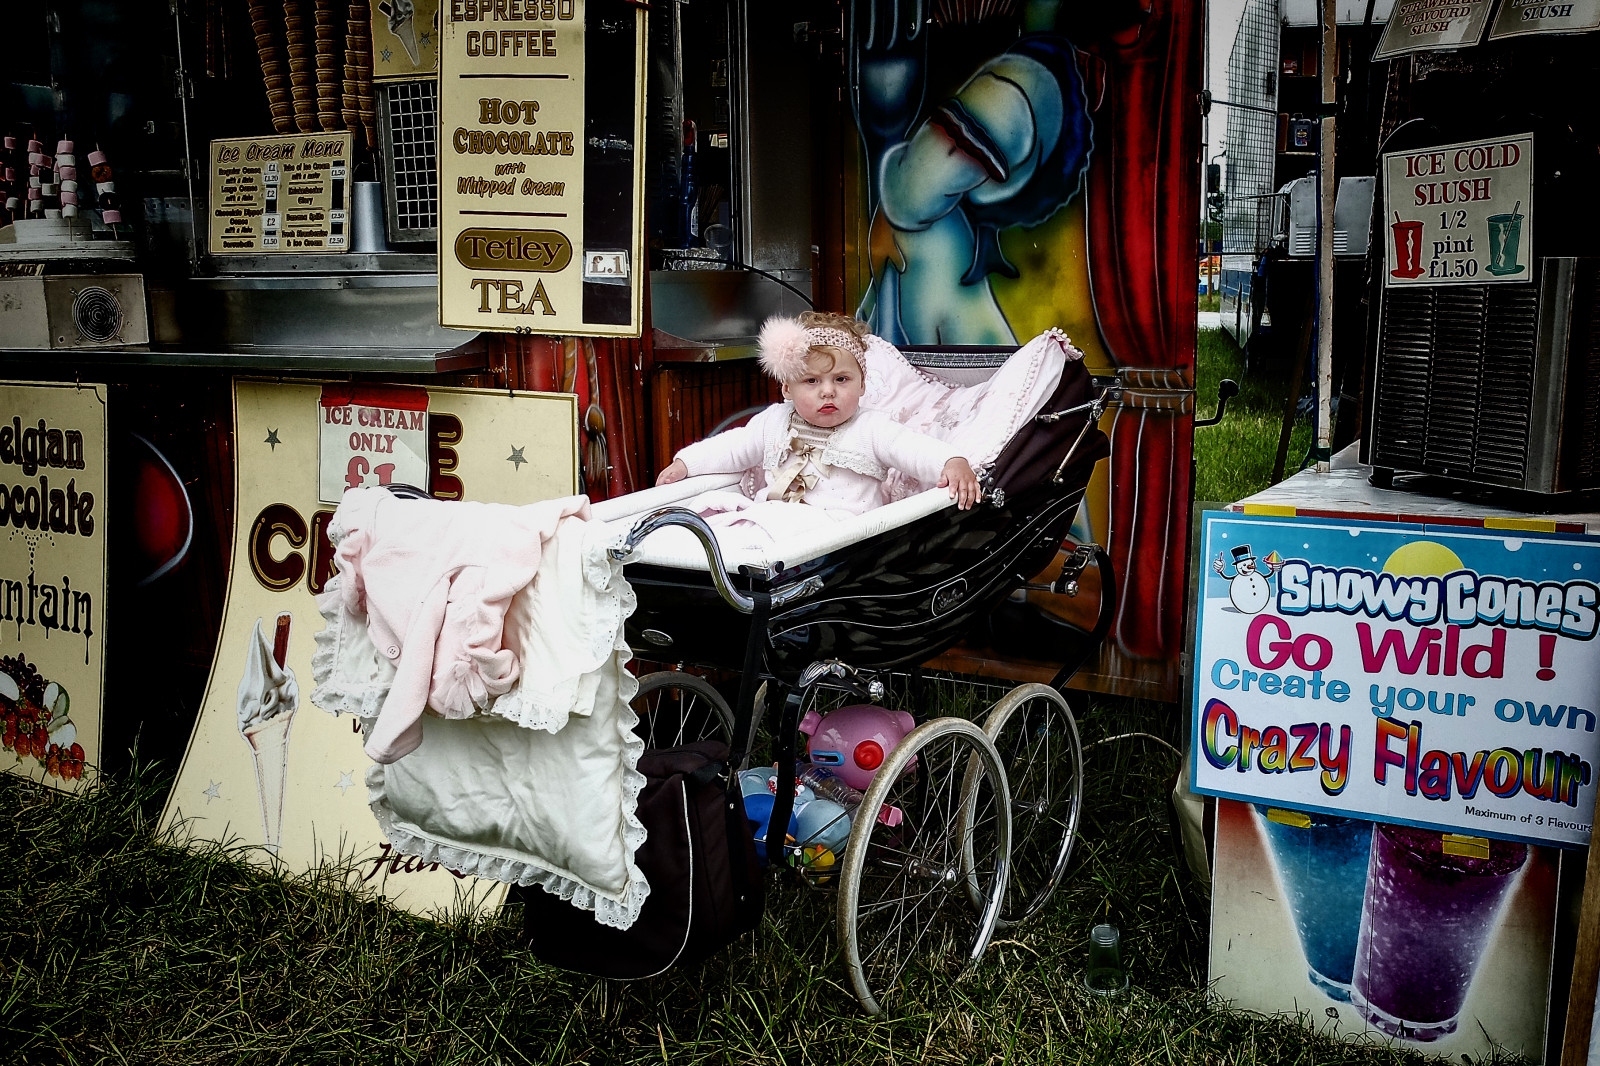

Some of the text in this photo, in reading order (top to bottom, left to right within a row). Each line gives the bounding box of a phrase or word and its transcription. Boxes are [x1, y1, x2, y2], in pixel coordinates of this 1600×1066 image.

[451, 0, 575, 21] ESPRESSO
[1402, 7, 1471, 26] FLAVOURD
[1521, 4, 1574, 20] SLUSH
[1410, 21, 1451, 35] SLUSH
[466, 30, 557, 57] COFFEE
[479, 98, 540, 124] HOT
[217, 139, 344, 163] Ice Cream Menu
[453, 127, 574, 156] CHOCOLATE
[331, 169, 346, 177] £1.50
[494, 162, 526, 177] with
[1405, 143, 1521, 178] ICE COLD
[457, 176, 565, 198] Whipped Cream
[1414, 177, 1492, 206] SLUSH
[267, 218, 276, 226] £2
[1439, 210, 1468, 230] 1/2
[463, 235, 564, 266] Tetley
[1432, 234, 1475, 259] pint
[1428, 259, 1479, 278] £1.50
[470, 278, 557, 316] TEA
[325, 405, 425, 431] ICE CREAM
[0, 416, 86, 476] elgian
[349, 431, 397, 453] ONLY
[344, 455, 396, 492] £1
[0, 476, 95, 537] ocolate
[1278, 562, 1598, 638] Snowy Cones
[1246, 614, 1557, 681] Go Wild !
[1211, 658, 1596, 732] Create your own
[1201, 698, 1592, 807] Crazy Flavour
[1465, 805, 1516, 822] Maximum
[1519, 813, 1533, 824] of
[1535, 815, 1544, 825] 3
